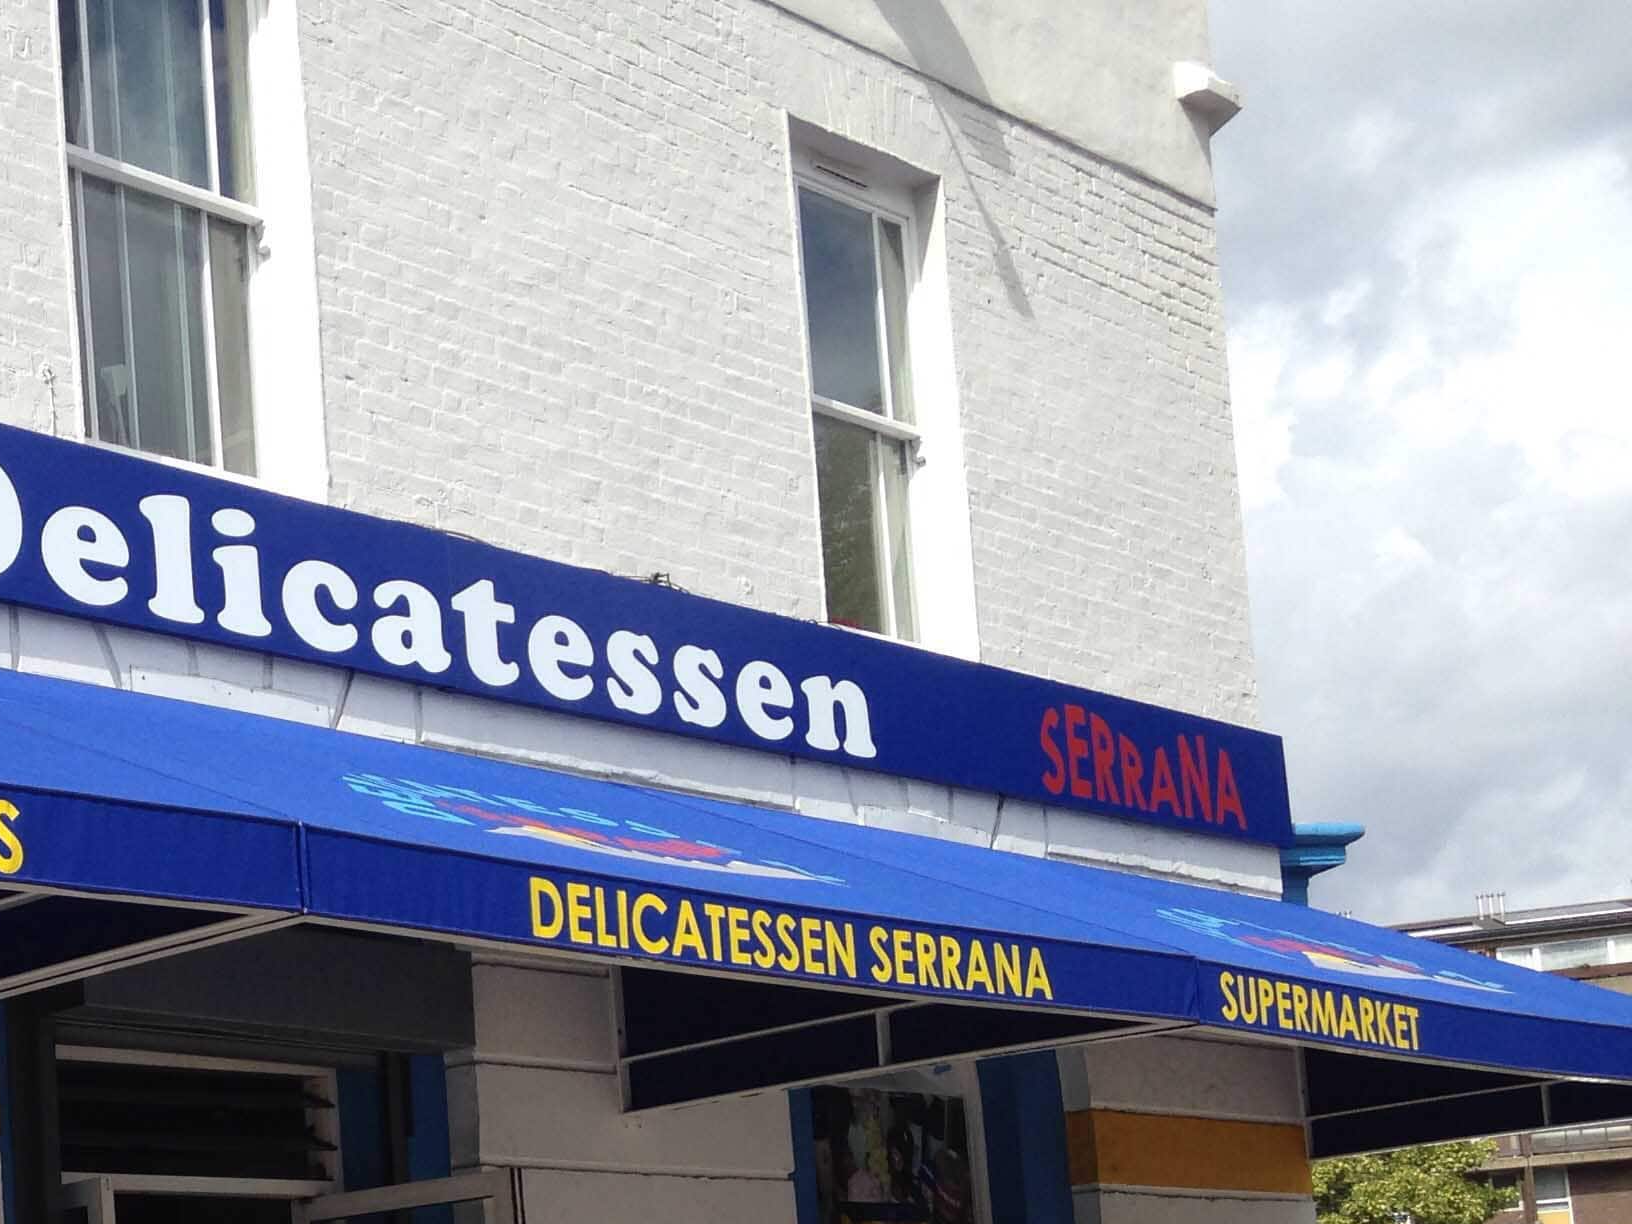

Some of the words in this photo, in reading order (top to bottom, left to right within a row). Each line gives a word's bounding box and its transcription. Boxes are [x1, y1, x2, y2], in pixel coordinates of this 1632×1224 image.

[1041, 704, 1248, 830] SERRANA
[529, 876, 857, 978] DELICATESSEN
[869, 926, 1054, 1001] SERRANA
[1220, 971, 1421, 1052] SUPERMARKET
